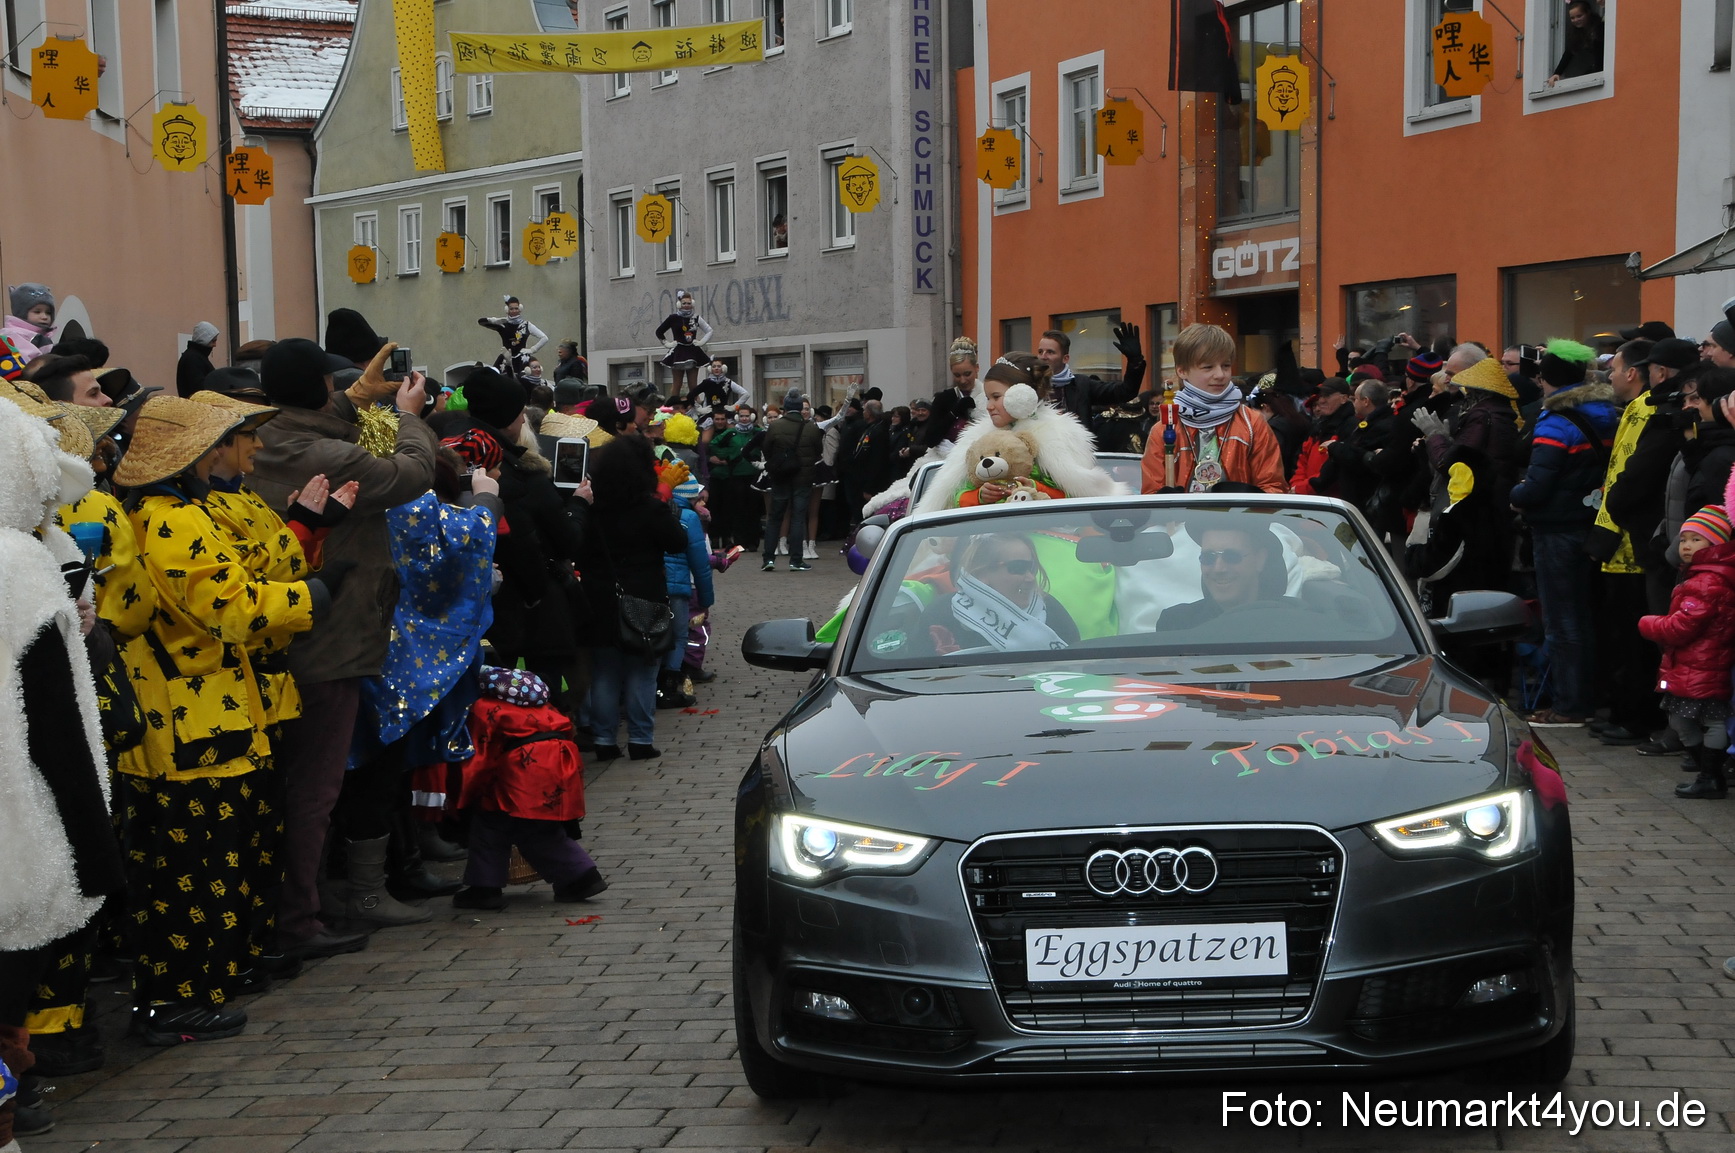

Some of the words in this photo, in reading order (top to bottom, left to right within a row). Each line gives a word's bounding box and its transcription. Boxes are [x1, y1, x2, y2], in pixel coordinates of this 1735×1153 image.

[914, 110, 933, 289] SCHMUCK
[1212, 237, 1300, 280] GÖTZ
[725, 273, 792, 326] OEXL
[813, 751, 978, 791] Lilly
[981, 760, 1040, 787] I
[1211, 726, 1433, 778] Tobias
[1443, 722, 1482, 743] I
[1034, 931, 1281, 978] Eggspatzen
[1172, 980, 1203, 988] quattro
